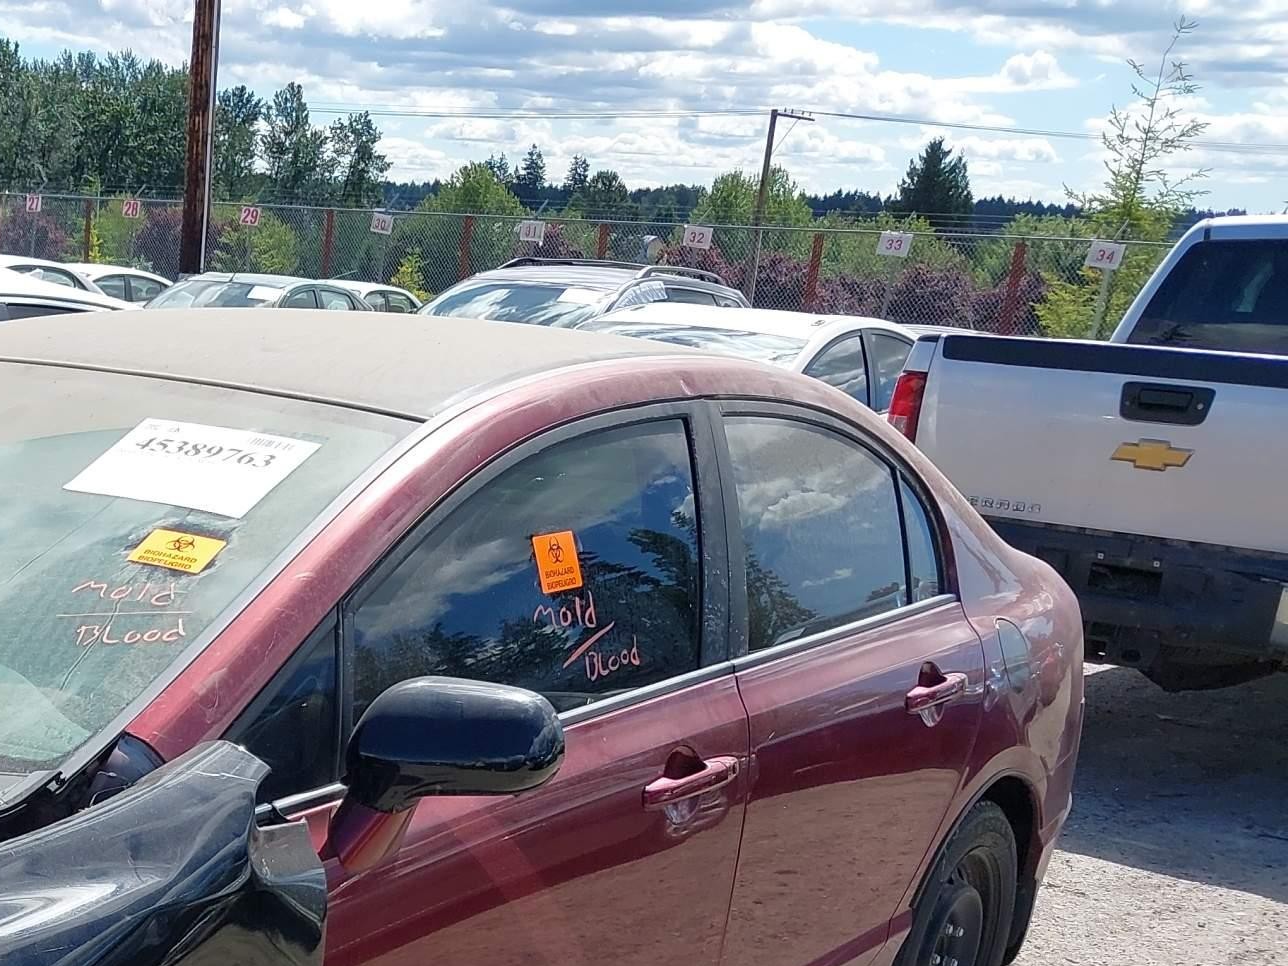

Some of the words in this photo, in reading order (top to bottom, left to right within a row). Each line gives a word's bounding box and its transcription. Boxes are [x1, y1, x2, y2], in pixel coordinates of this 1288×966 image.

[28, 195, 40, 211] 27
[123, 201, 139, 217] 28
[241, 207, 258, 225] 29
[375, 217, 386, 230] 30
[526, 223, 537, 238] 31
[689, 231, 705, 244] 32
[885, 238, 903, 251] 33
[1096, 249, 1115, 264] 34
[135, 436, 276, 468] 45389763
[143, 549, 198, 564] BIOHAZARD
